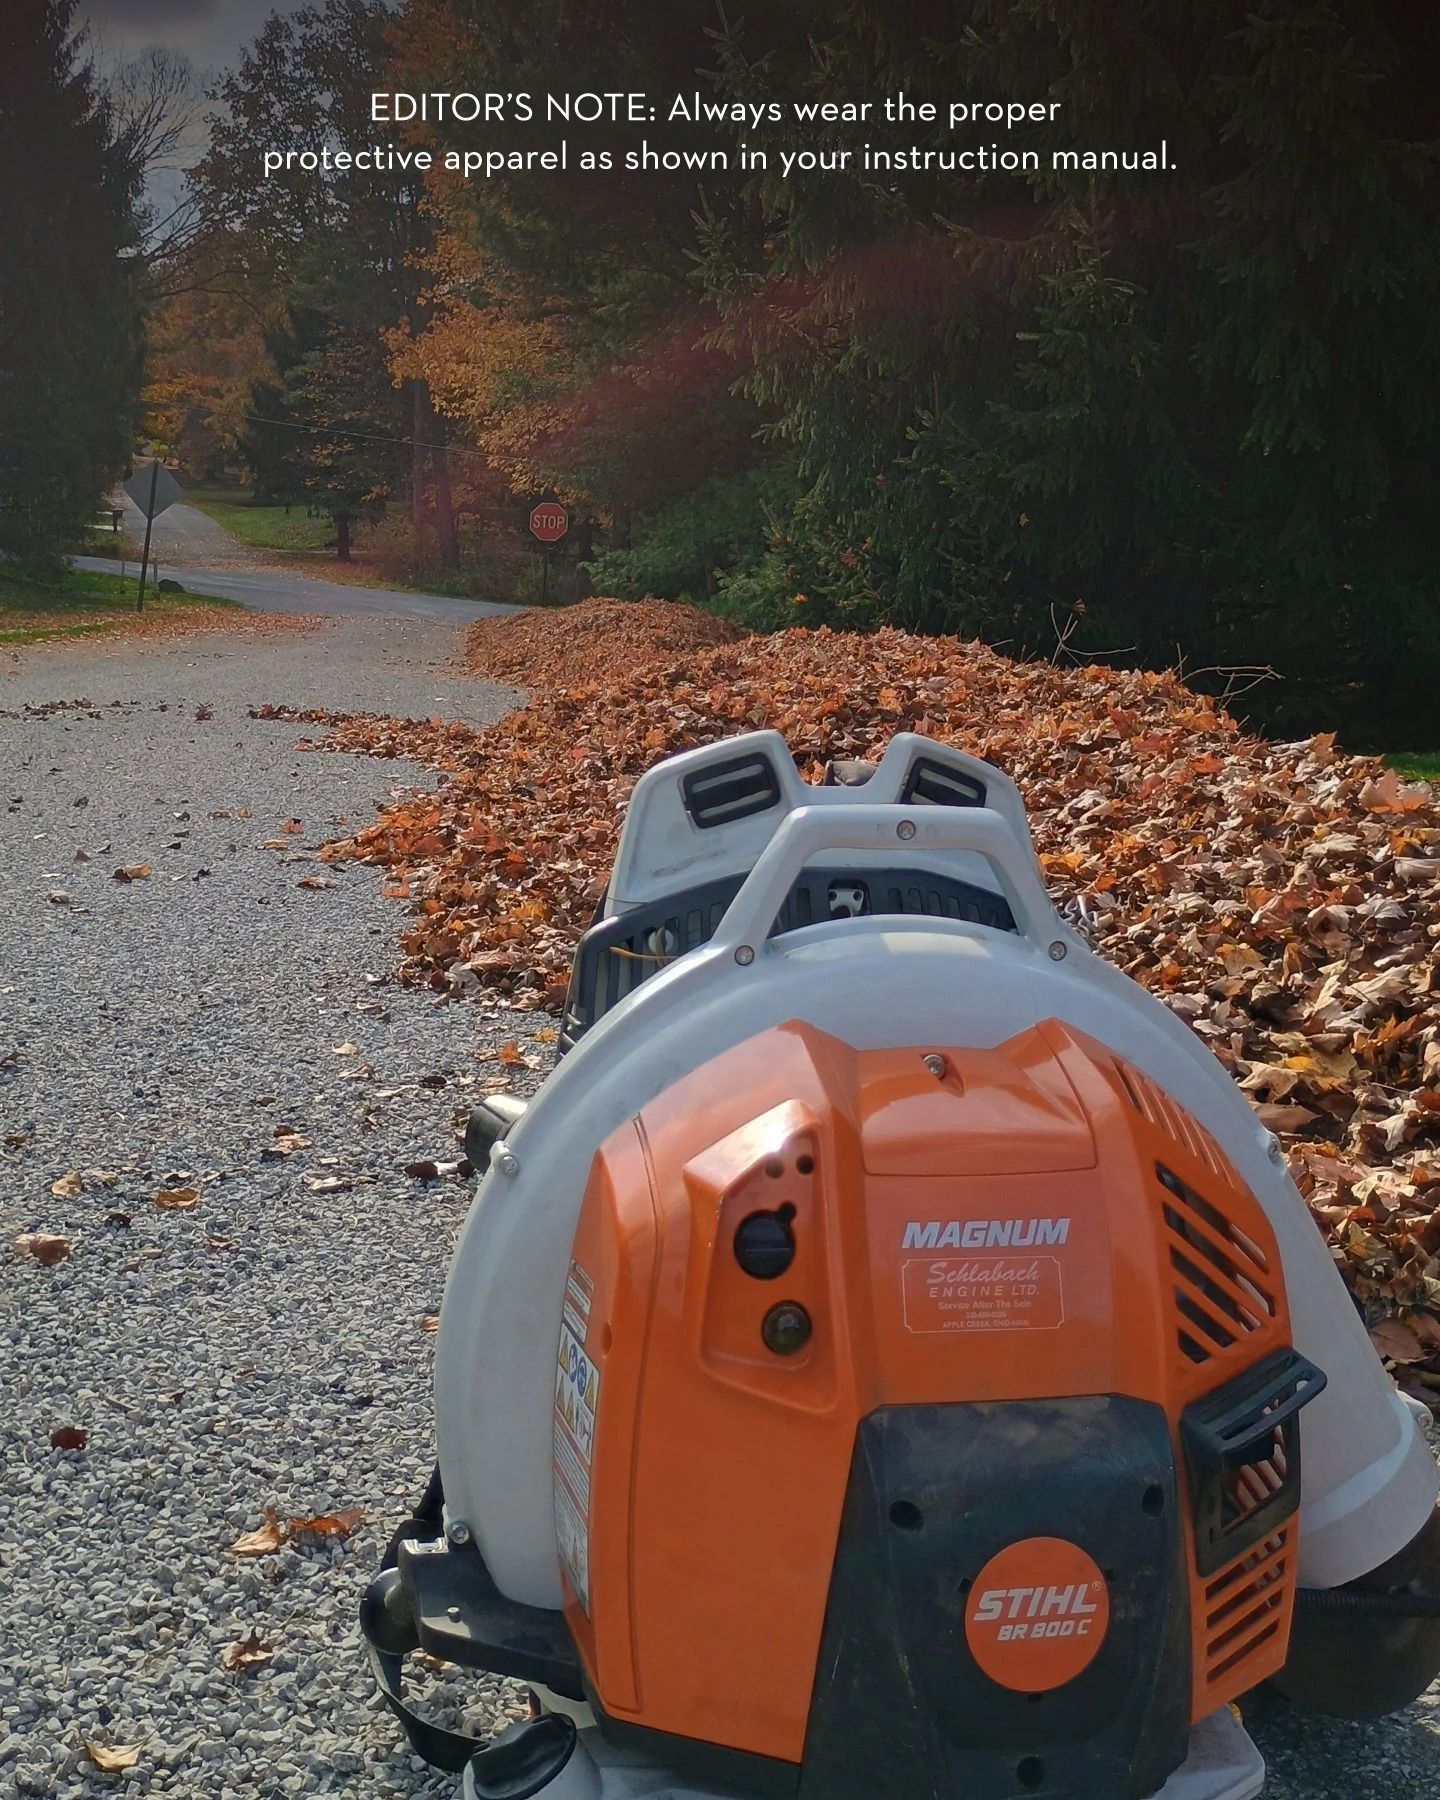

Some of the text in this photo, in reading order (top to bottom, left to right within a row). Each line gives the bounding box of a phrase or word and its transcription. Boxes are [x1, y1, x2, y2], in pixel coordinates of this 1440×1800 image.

[532, 514, 566, 530] STOP
[902, 1218, 1070, 1249] MAGNUM
[926, 1260, 1040, 1284] Schlabach
[929, 1285, 1004, 1298] ENGINE
[937, 1300, 970, 1310] Service
[995, 1299, 1012, 1308] The
[973, 1584, 1097, 1621] STIHL
[997, 1618, 1092, 1641] BR 800 C
